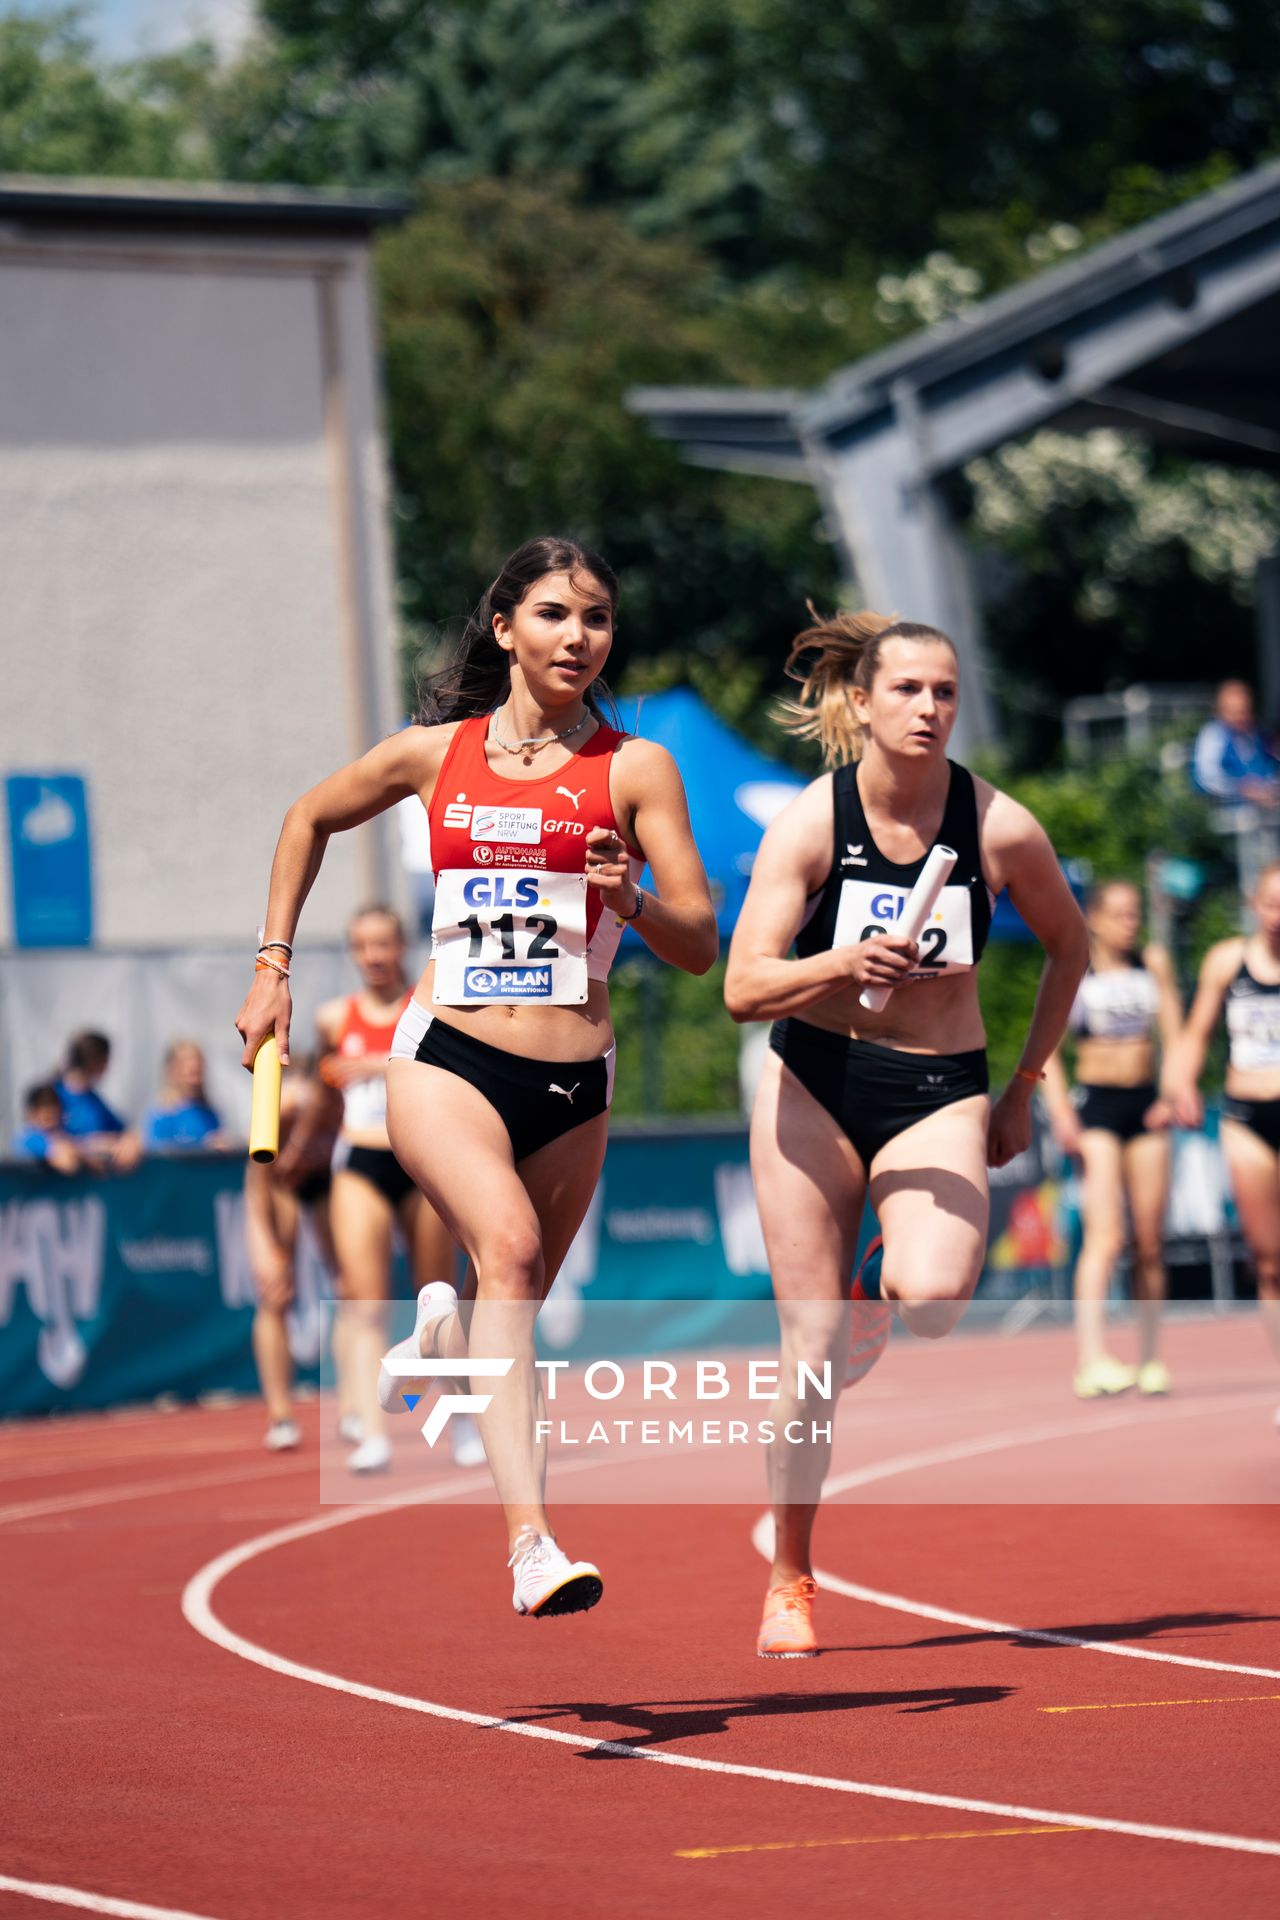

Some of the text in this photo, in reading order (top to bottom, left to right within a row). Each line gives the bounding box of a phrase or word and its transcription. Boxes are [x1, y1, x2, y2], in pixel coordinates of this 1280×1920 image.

[499, 813, 526, 821] SPORT
[498, 821, 538, 830] STIFTUNG
[543, 820, 585, 836] GfTD
[497, 829, 519, 838] NRW
[494, 846, 547, 857] AUTOHAUS
[494, 854, 547, 865] PFLANZ
[458, 913, 559, 960] 112
[500, 972, 549, 986] PLAN
